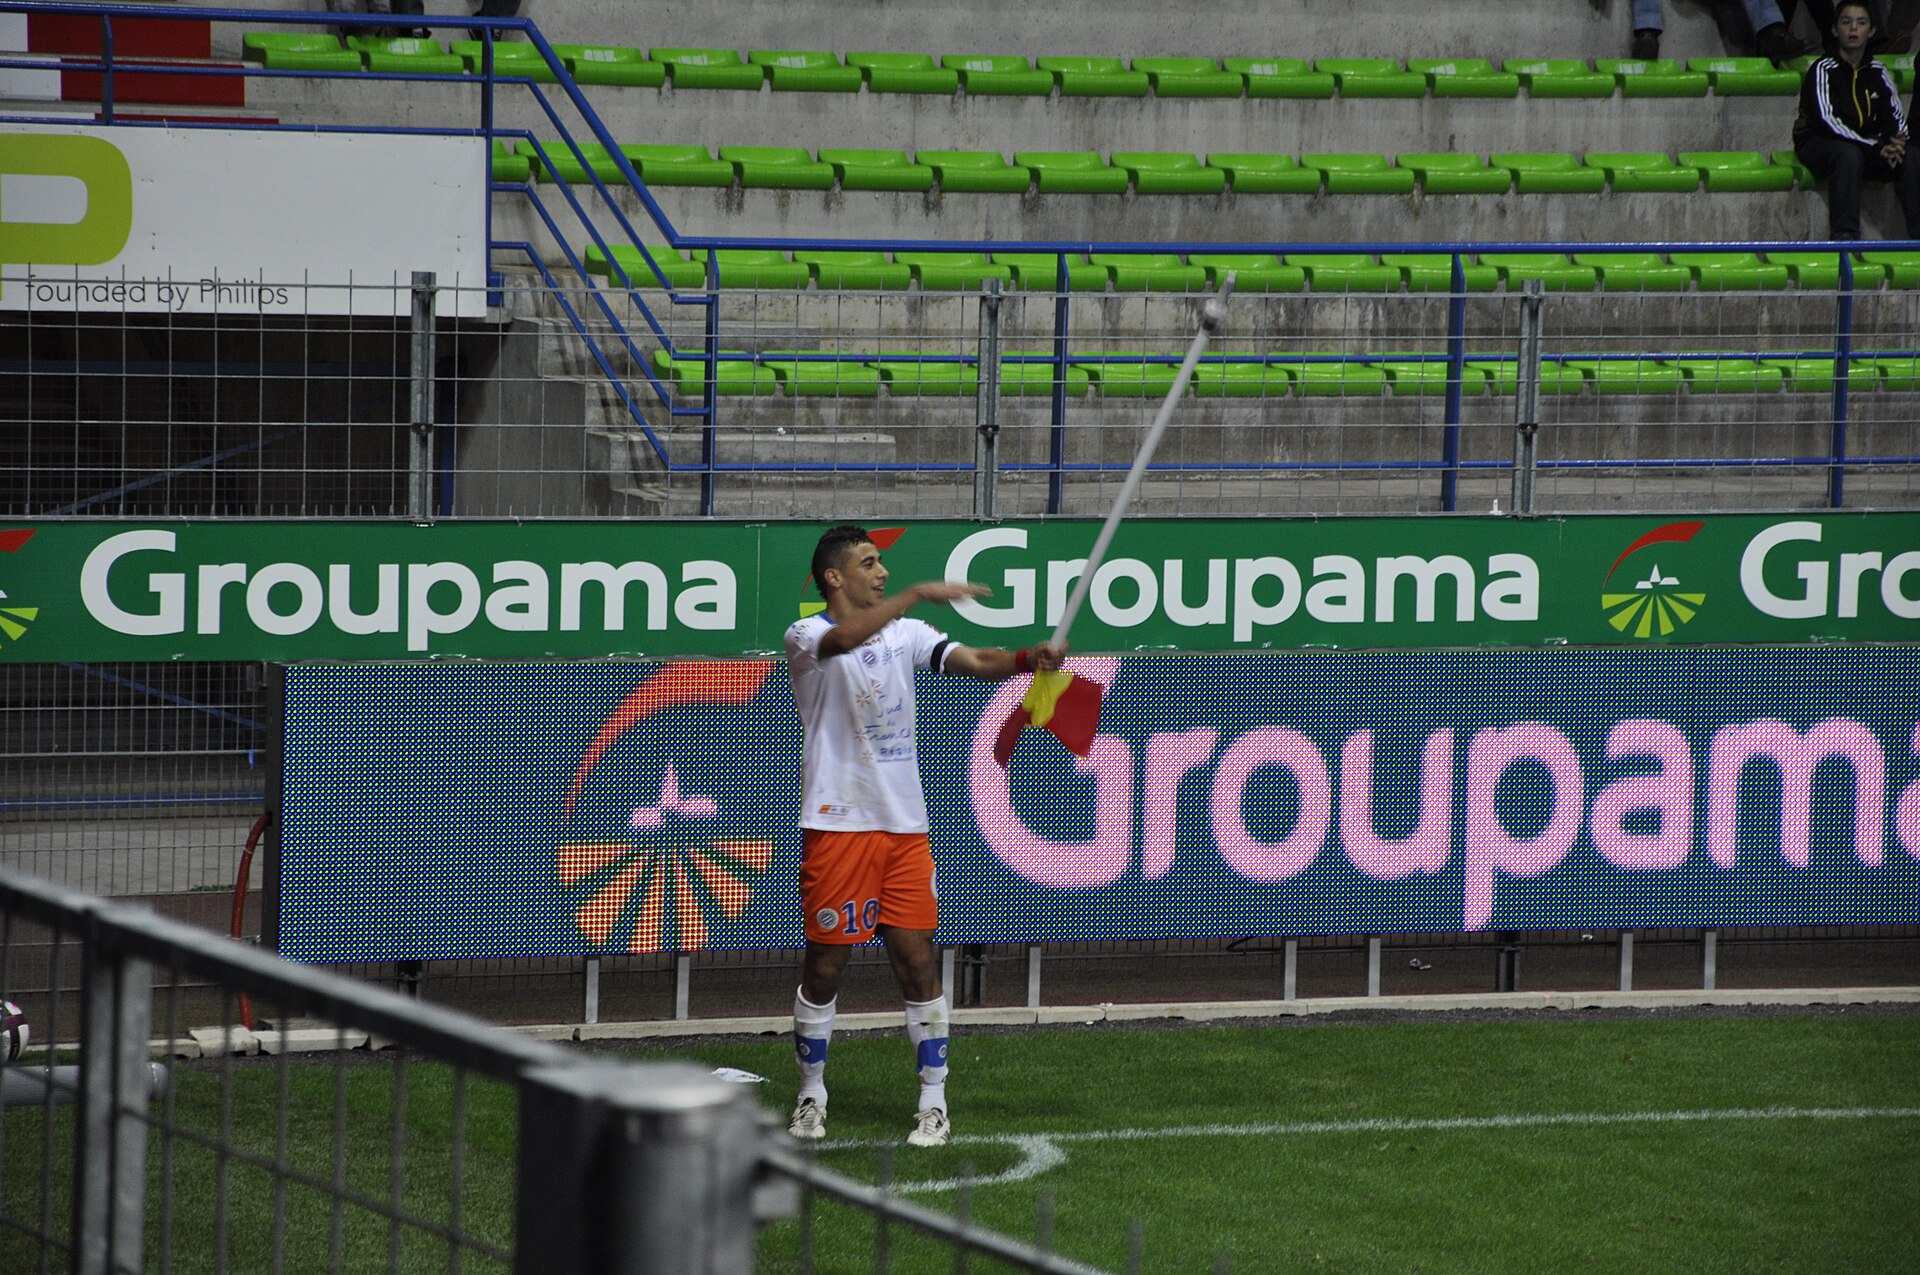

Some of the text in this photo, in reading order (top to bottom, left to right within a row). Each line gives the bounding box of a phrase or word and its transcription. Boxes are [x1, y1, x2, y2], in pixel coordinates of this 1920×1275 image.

[26, 274, 288, 312] founded by Philips
[80, 530, 737, 651] Groupama
[944, 528, 1539, 642] Groupama
[969, 656, 1920, 931] Groupam
[840, 898, 880, 935] 10
